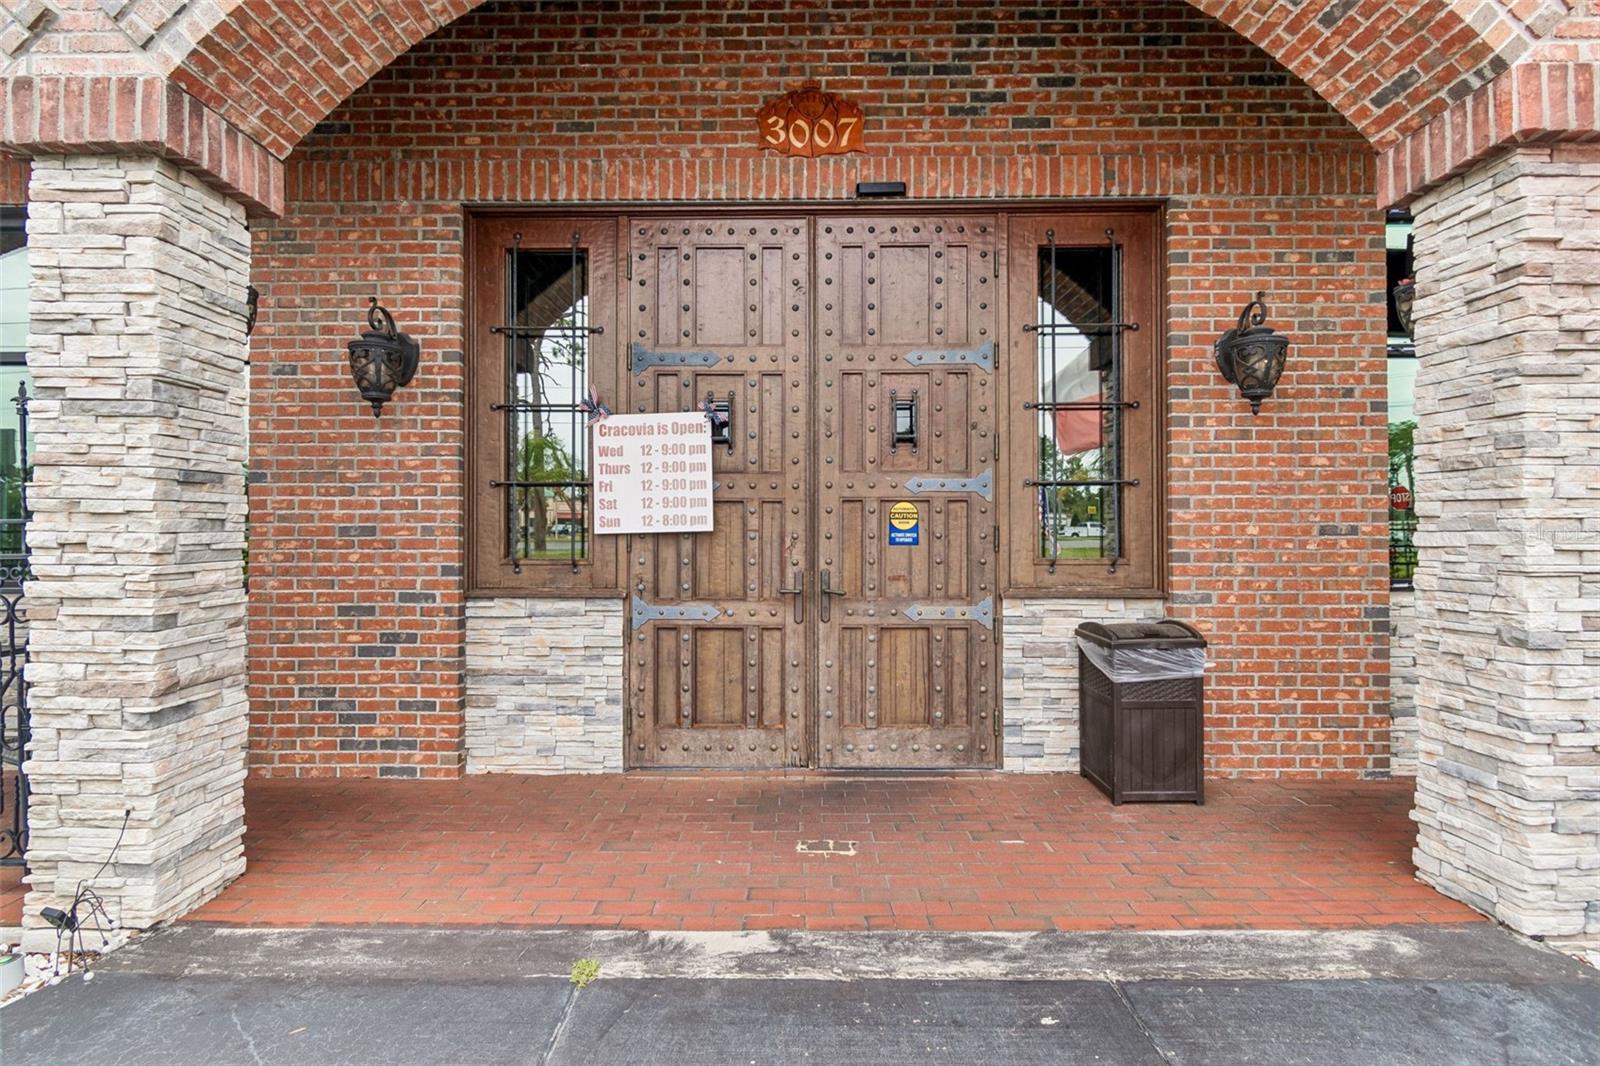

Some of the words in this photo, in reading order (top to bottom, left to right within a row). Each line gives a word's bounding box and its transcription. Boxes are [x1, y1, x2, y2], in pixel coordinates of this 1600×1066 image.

[766, 116, 858, 148] 3007
[600, 422, 654, 437] Cracovia
[657, 422, 668, 435] is
[672, 422, 706, 436] Open:
[598, 445, 624, 457] Wed
[640, 444, 652, 456] 12
[662, 443, 686, 455] 9:00
[689, 444, 706, 456] pm
[598, 463, 631, 475] Thurs
[641, 462, 652, 474] 12
[662, 461, 686, 473] 9:00
[689, 462, 706, 474] pm
[599, 480, 613, 492] Fri
[641, 480, 652, 492] 12
[662, 479, 687, 491] 9:00
[690, 480, 707, 492] pm
[599, 498, 618, 510] Sat
[642, 497, 653, 509] 12
[662, 496, 687, 508] 9:00
[690, 498, 707, 509] pm
[599, 516, 620, 528] Sun
[642, 515, 654, 527] 12
[663, 514, 687, 526] 8:00
[690, 516, 707, 527] pm
